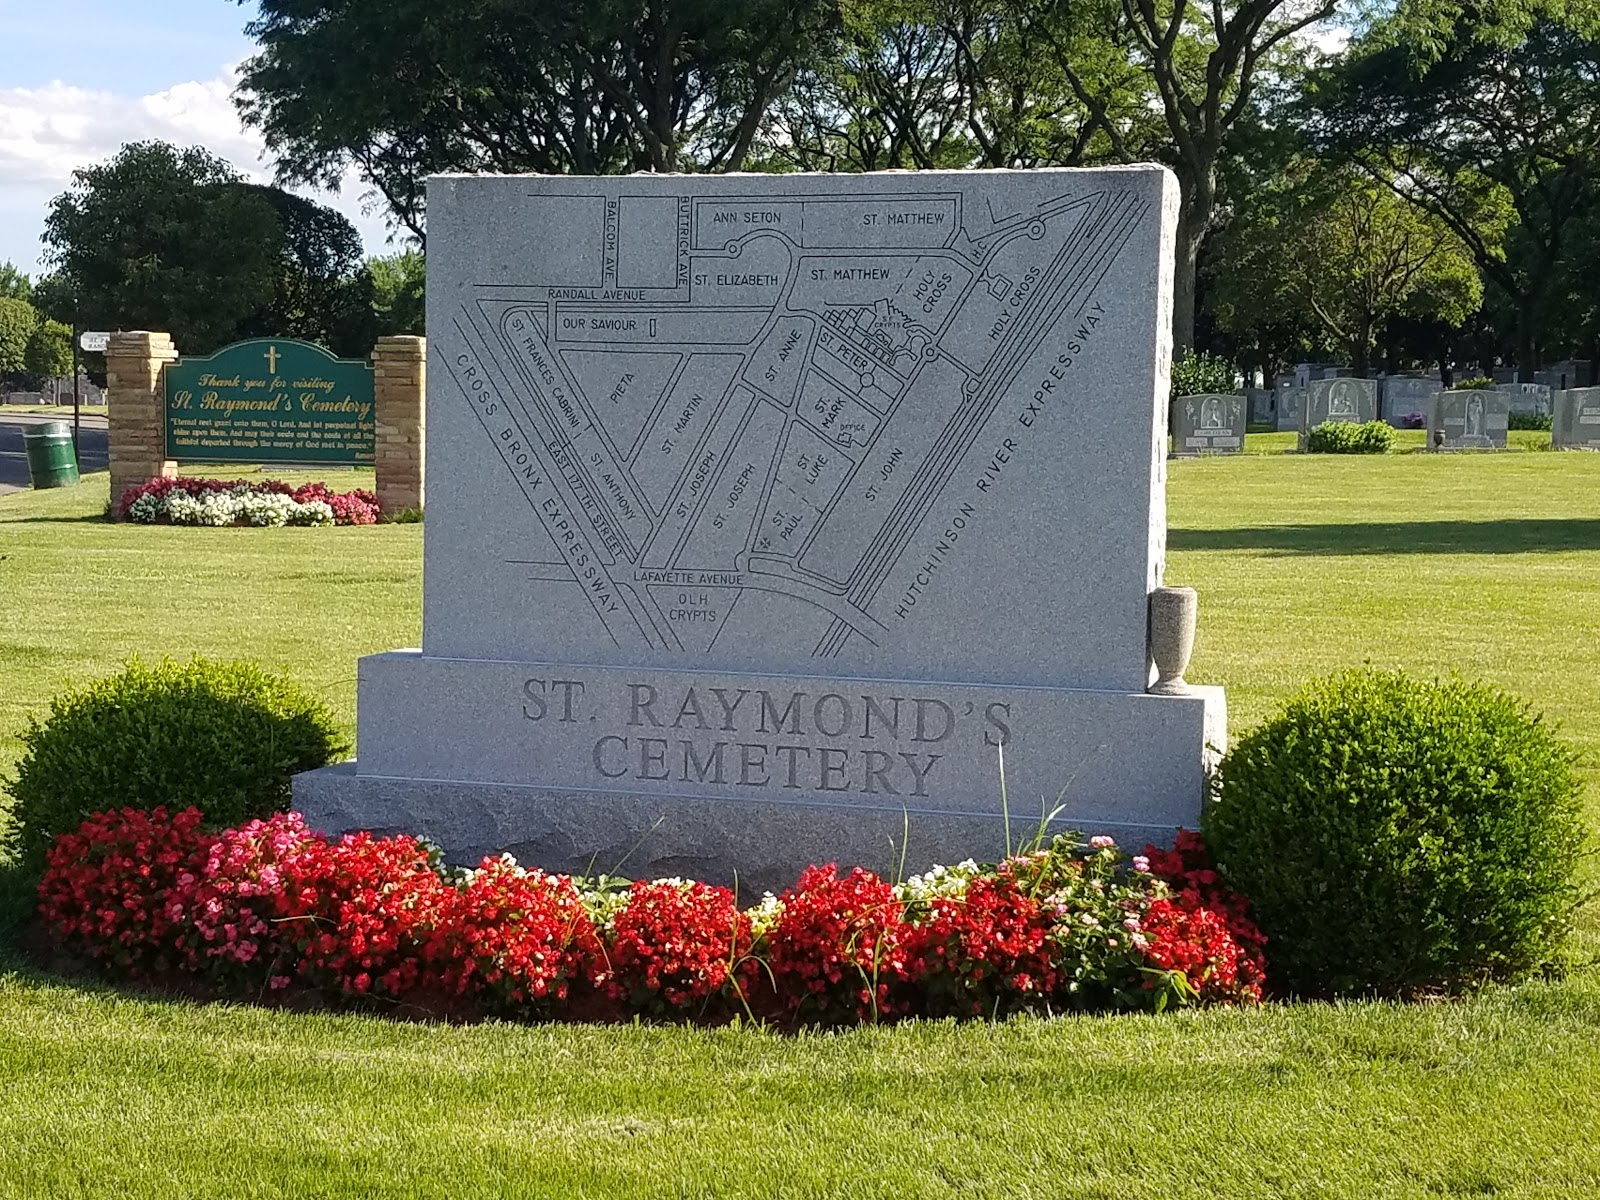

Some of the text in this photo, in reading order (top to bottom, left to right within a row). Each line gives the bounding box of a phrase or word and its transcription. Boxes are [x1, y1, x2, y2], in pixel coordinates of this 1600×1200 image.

[680, 196, 690, 257] BUTTRICK
[714, 212, 782, 223] ANN SETON
[863, 213, 944, 225] ST. MATTHEW
[604, 202, 617, 283] BALCOM AVE.
[695, 275, 778, 286] ST. ELIZABETH
[811, 268, 890, 280] ST. MATTHEW
[913, 270, 936, 301] HOLY
[548, 288, 646, 300] RANDALL AVENUE
[922, 272, 952, 314] CROSS
[988, 265, 1041, 341] HOLY CROSS
[563, 318, 636, 330] OUR SAVIOUR
[765, 329, 802, 382] ST. ANNE
[820, 332, 868, 370] ST. PETER
[198, 374, 336, 394] Thank you for visiting
[512, 318, 580, 428] ST. FRANCES CABRINI
[610, 373, 636, 404] PIETA
[172, 390, 372, 420] St. Raymond's Cemetery
[814, 396, 831, 414] ST.
[822, 398, 846, 429] MARK
[230, 429, 242, 437] And
[324, 422, 356, 430] perpetual
[662, 394, 703, 455] ST. MARTIN
[201, 438, 230, 448] departed
[232, 440, 258, 448] through
[273, 442, 294, 450] mercy
[296, 440, 303, 448] of
[305, 440, 320, 448] God
[805, 454, 829, 486] LUKE
[866, 448, 904, 502] ST. JOHN
[894, 301, 1107, 620] HUTCHINSON RIVER EXPRESSWAY
[457, 354, 620, 614] CROSS BRONX EXPRESSWAY
[549, 441, 571, 470] EAST
[594, 515, 624, 557] STREET
[603, 474, 636, 521] ANTHONY
[676, 450, 718, 518] ST. JOSEPH
[713, 464, 756, 530] ST. JOSEPH
[772, 511, 789, 528] ST.
[780, 514, 804, 541] PAUL
[634, 571, 744, 586] LAFAYETTE AVENUE
[669, 609, 717, 622] CRYPTS
[522, 678, 1013, 747] ST. RAYMOND'S
[592, 735, 943, 798] CEMETERY
